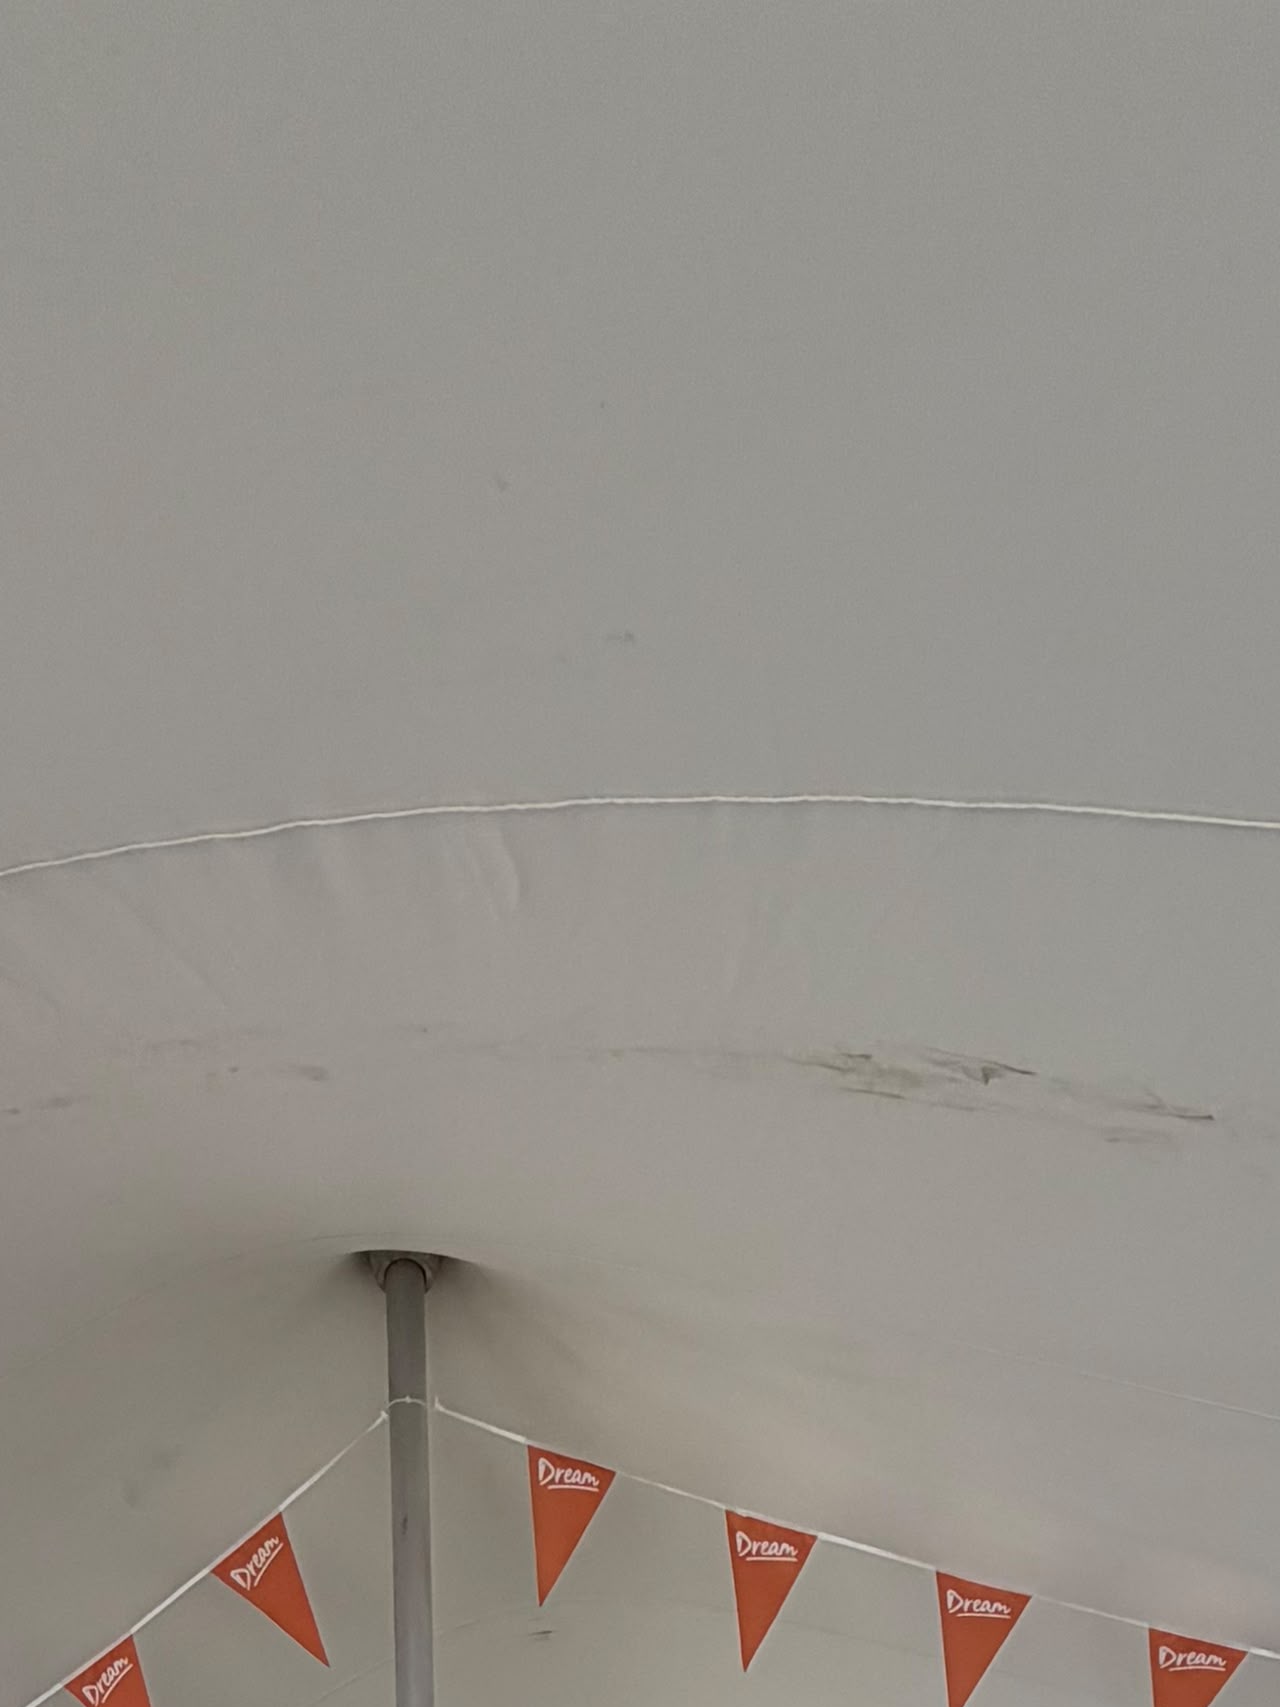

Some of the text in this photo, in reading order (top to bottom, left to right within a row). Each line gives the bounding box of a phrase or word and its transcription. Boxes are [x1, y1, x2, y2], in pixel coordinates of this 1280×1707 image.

[539, 1458, 599, 1491] Dream
[736, 1531, 797, 1561] Dream
[230, 1537, 283, 1590] Dream
[947, 1590, 1010, 1618] Dream
[1159, 1646, 1226, 1671] Dream
[82, 1658, 132, 1706] Dream
